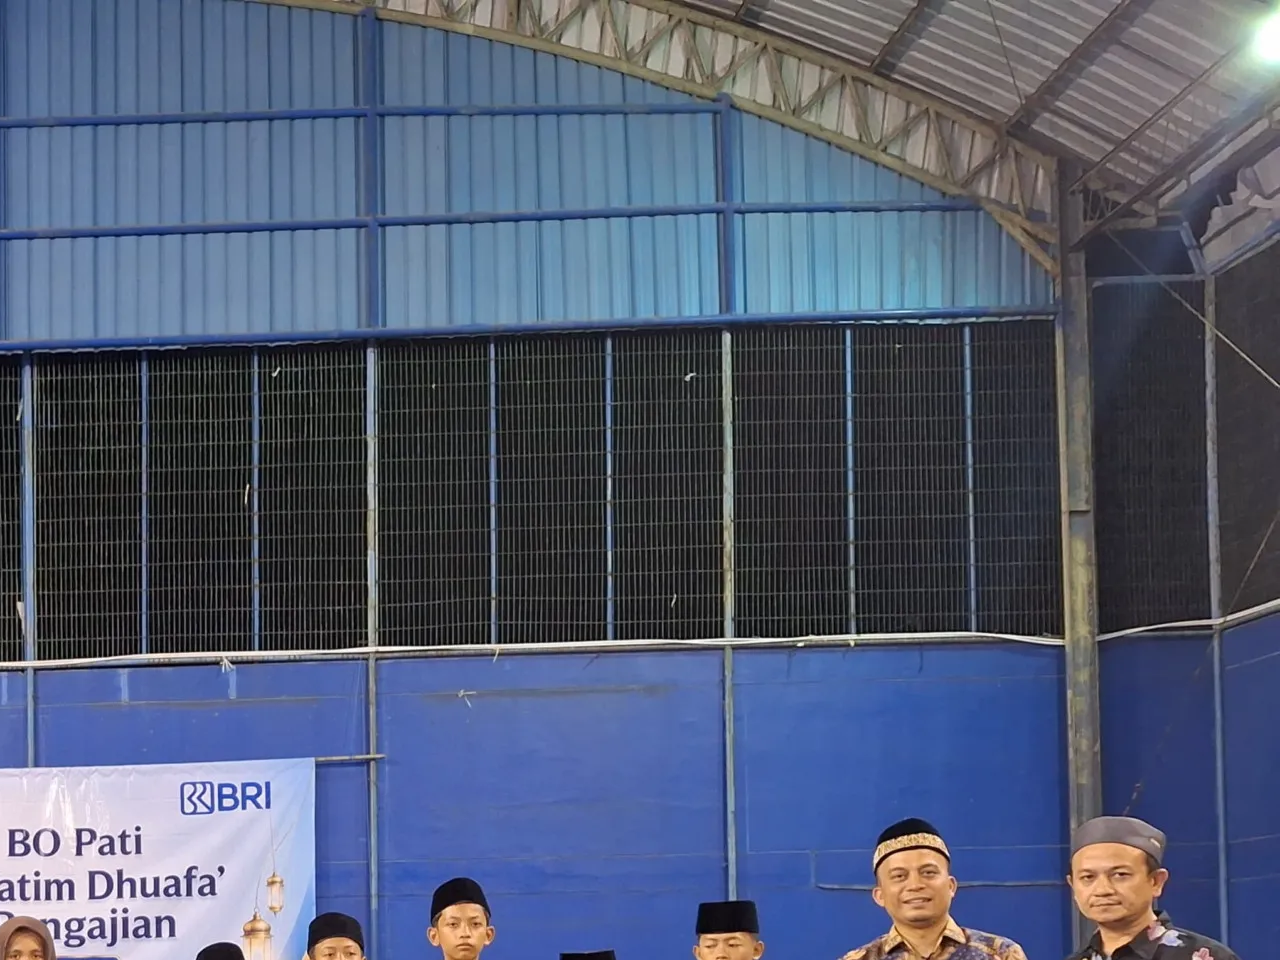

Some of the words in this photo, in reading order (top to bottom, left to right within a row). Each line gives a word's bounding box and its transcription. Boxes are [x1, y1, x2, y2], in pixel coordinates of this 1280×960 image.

[217, 781, 271, 812] BRI
[8, 828, 61, 857] BO
[75, 825, 143, 856] Pati
